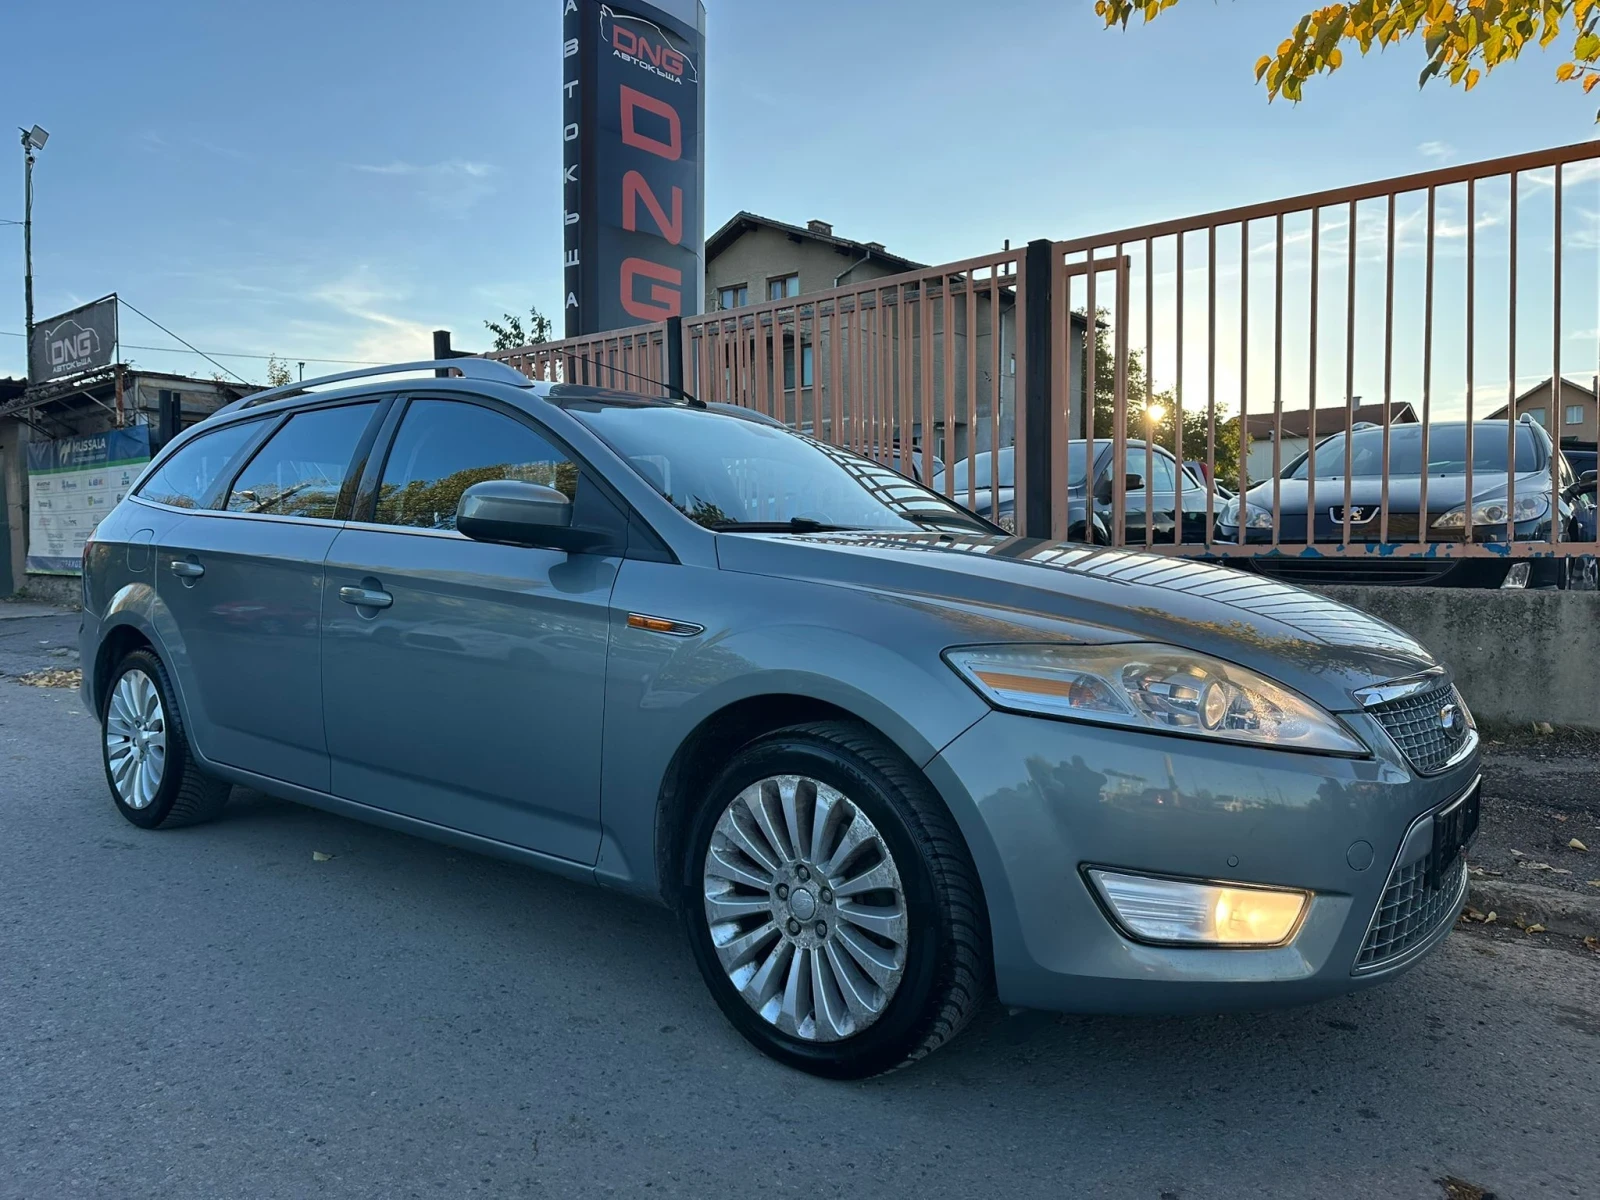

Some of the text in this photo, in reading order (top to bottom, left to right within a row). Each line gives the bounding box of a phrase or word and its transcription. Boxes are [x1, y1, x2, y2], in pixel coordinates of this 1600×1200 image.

[612, 24, 684, 76] DNG
[620, 84, 683, 323] DNG
[51, 331, 91, 365] DNG
[72, 437, 106, 453] MUSSALA
